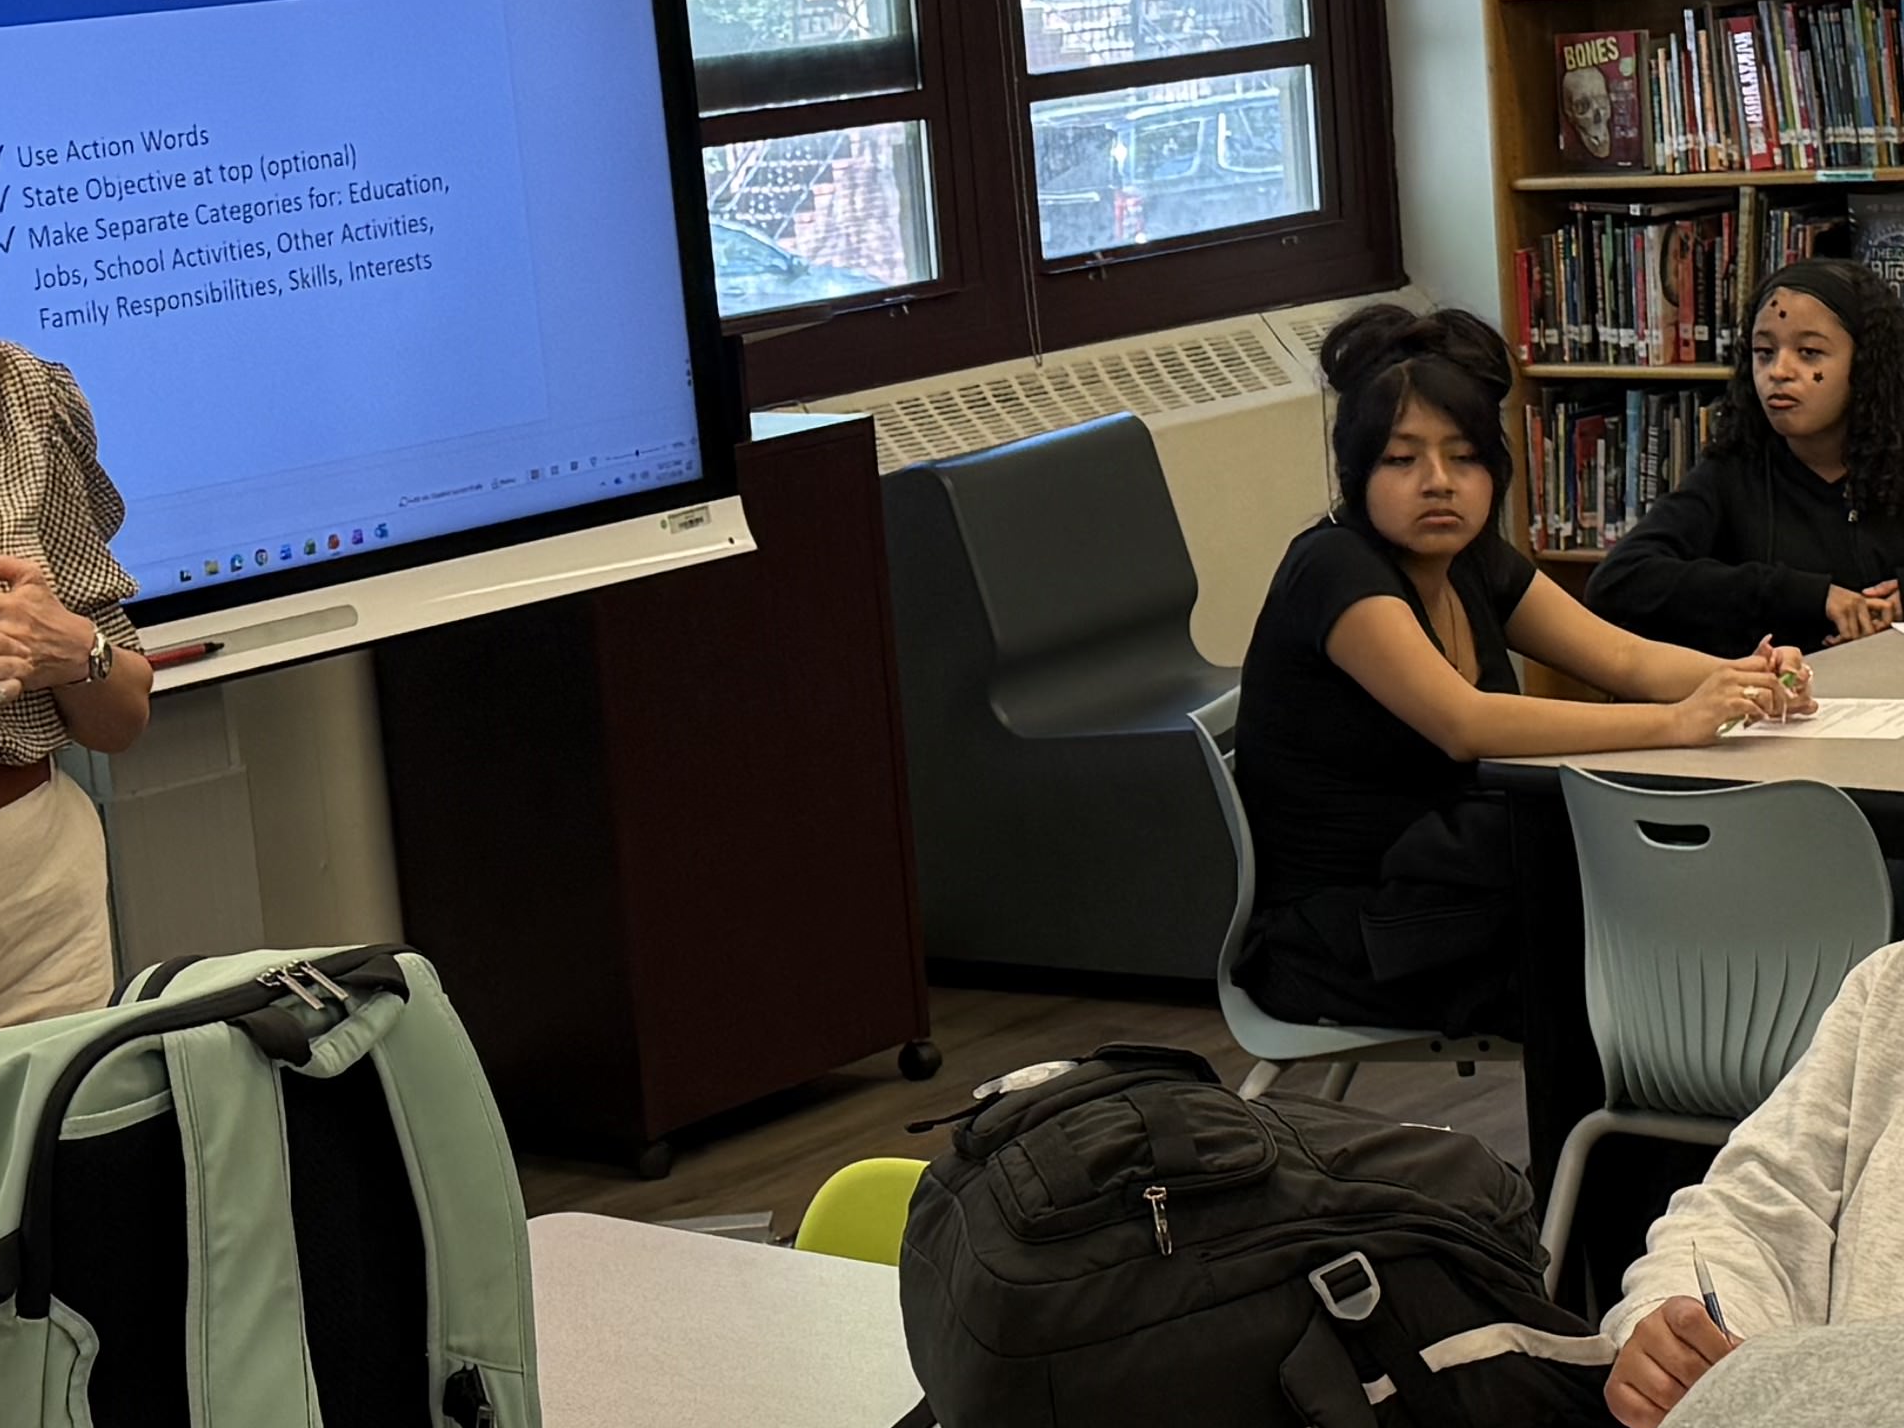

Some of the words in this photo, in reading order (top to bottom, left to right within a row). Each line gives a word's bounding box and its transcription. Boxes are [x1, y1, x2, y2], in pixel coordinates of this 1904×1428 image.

[1563, 35, 1620, 71] BONES
[16, 144, 58, 169] Use
[66, 137, 135, 163] Action
[141, 124, 210, 155] Words
[22, 183, 79, 209] State
[85, 169, 187, 201] Objective
[193, 167, 213, 186] at
[219, 161, 253, 187] top
[260, 142, 358, 182] (optional)
[27, 222, 90, 251] Make
[94, 210, 190, 244] Separate
[194, 195, 303, 228] Categories
[308, 184, 342, 209] for:
[348, 174, 451, 205] Education,
[34, 265, 90, 292] Jobs,
[94, 249, 166, 282] School
[171, 238, 273, 272] Activities,
[276, 227, 335, 254] Other
[340, 213, 436, 246] Activities,
[38, 300, 110, 330] Family
[116, 276, 284, 319] Responsibilities,
[288, 265, 344, 292] Skills,
[348, 251, 434, 284] Interests
